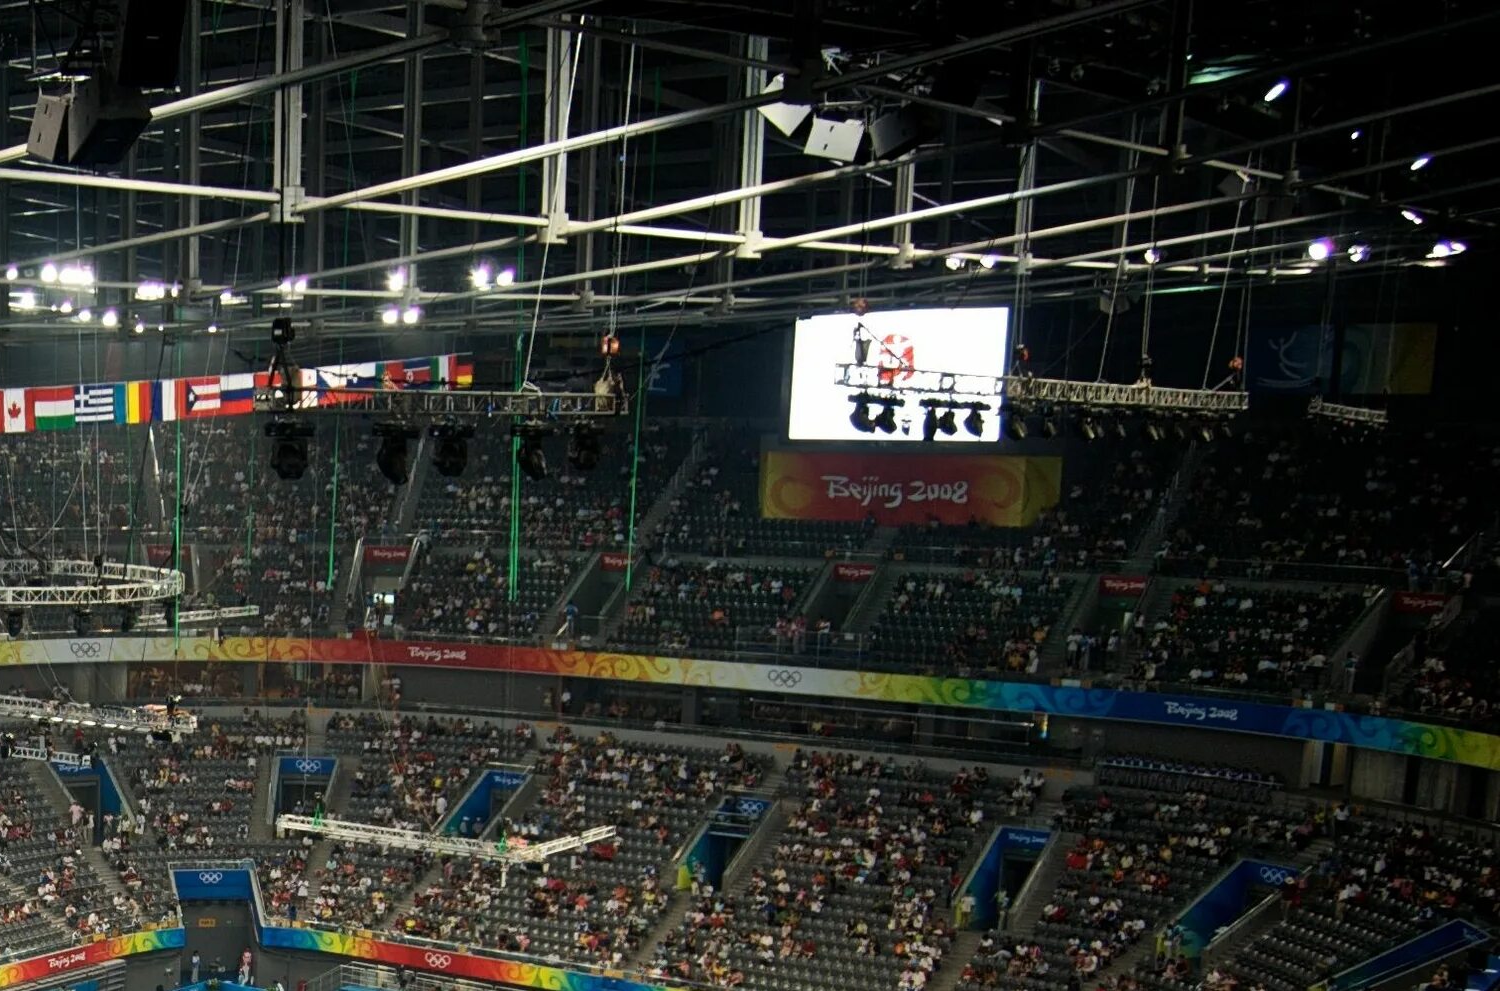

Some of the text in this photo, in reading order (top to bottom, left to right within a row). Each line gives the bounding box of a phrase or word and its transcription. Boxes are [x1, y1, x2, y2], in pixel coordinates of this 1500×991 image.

[821, 476, 968, 508] Beijing 2008
[408, 647, 467, 661] Beijing 2008
[1164, 701, 1238, 720] Beijing 2008
[48, 956, 70, 968] Beijing
